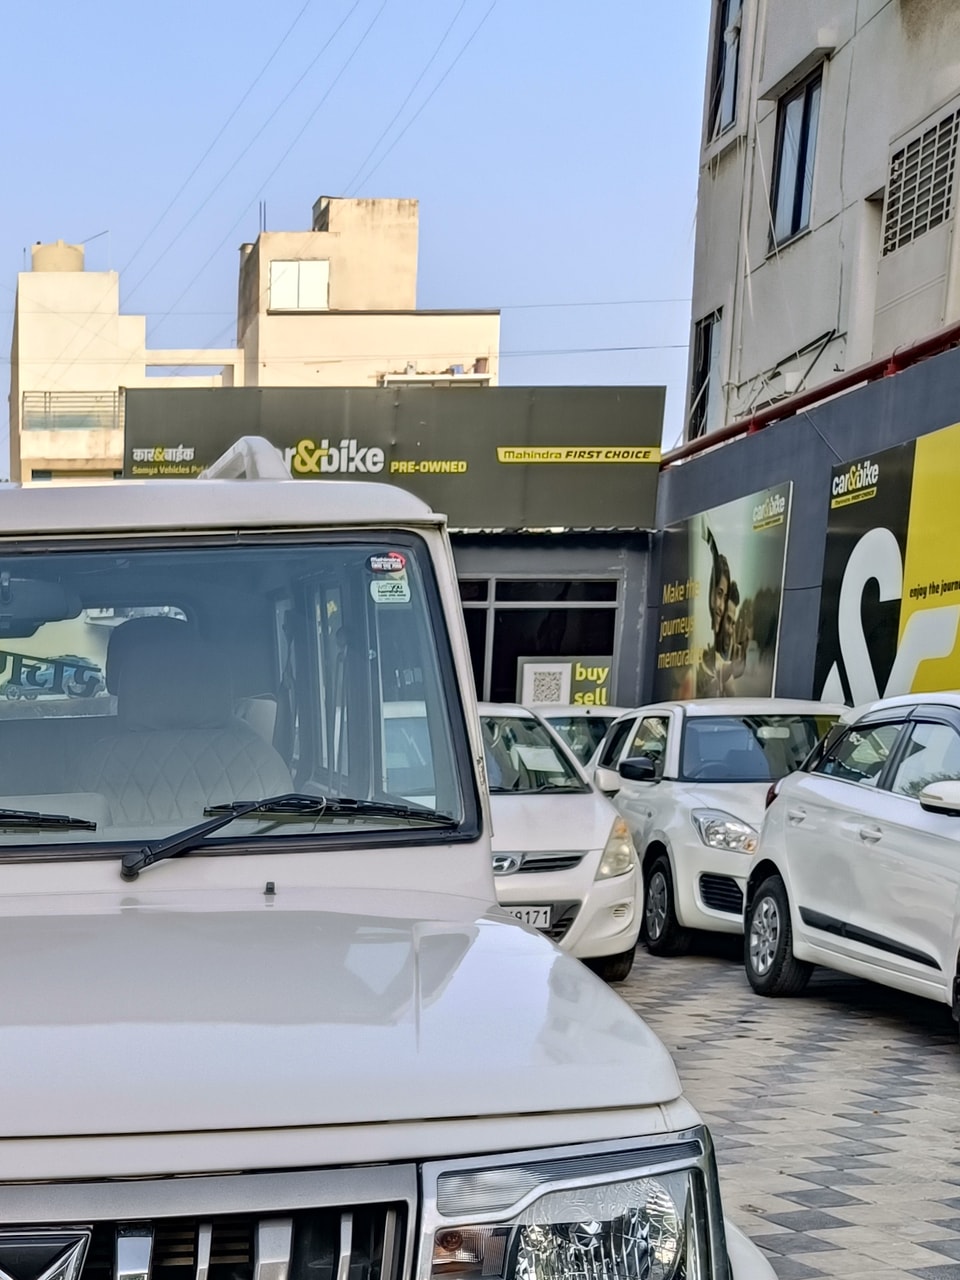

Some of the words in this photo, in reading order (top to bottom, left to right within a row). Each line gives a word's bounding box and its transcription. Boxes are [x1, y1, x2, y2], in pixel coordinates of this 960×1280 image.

[280, 440, 385, 473] r&bike
[503, 450, 562, 460] Mahindra
[565, 450, 602, 460] FIRST
[605, 450, 651, 460] CHOICE
[390, 460, 467, 473] PRE-OWNED
[832, 460, 880, 496] car&bike
[662, 580, 685, 605] Make
[910, 583, 928, 600] enjoy
[928, 581, 940, 595] the
[940, 579, 960, 597] journ
[658, 615, 695, 643] journeys
[575, 662, 610, 685] buy
[574, 687, 608, 705] sell
[510, 910, 548, 925] 9171
